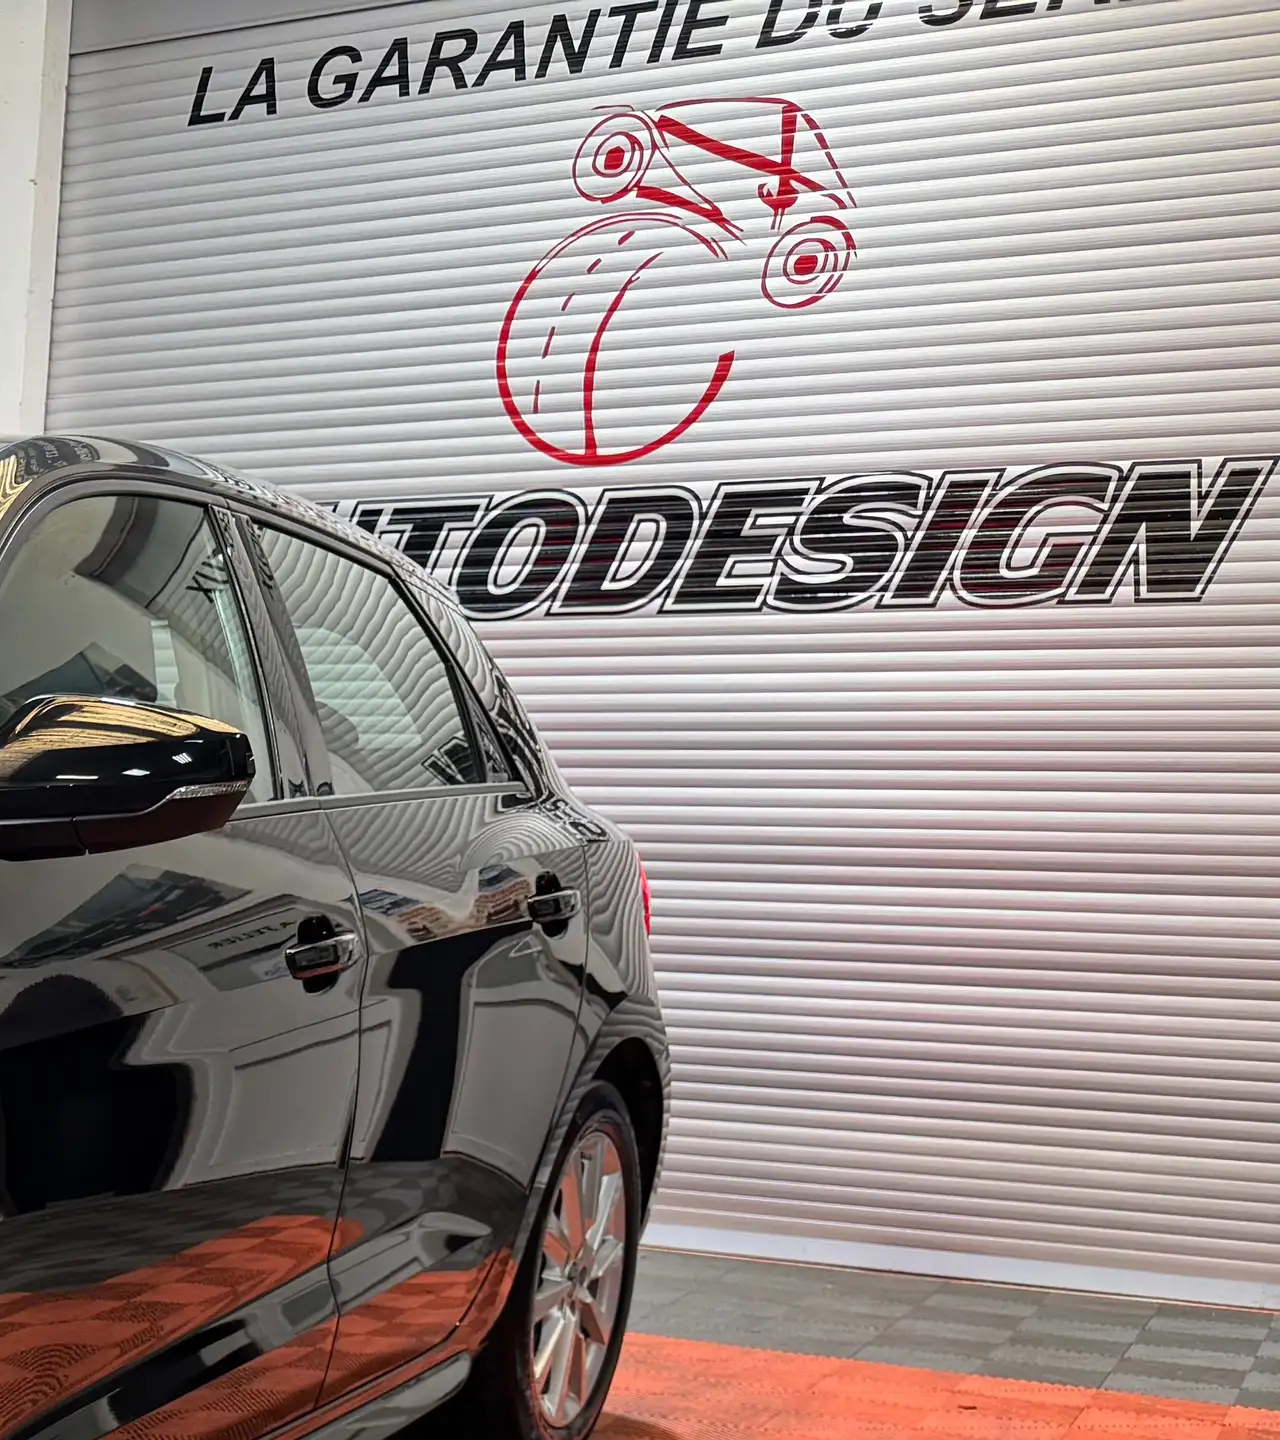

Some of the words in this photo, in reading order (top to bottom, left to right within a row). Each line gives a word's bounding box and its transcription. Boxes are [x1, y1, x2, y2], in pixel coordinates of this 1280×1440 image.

[187, 57, 277, 126] LA
[307, 0, 731, 110] GARANTIE
[316, 456, 1279, 620] TODESIGN
